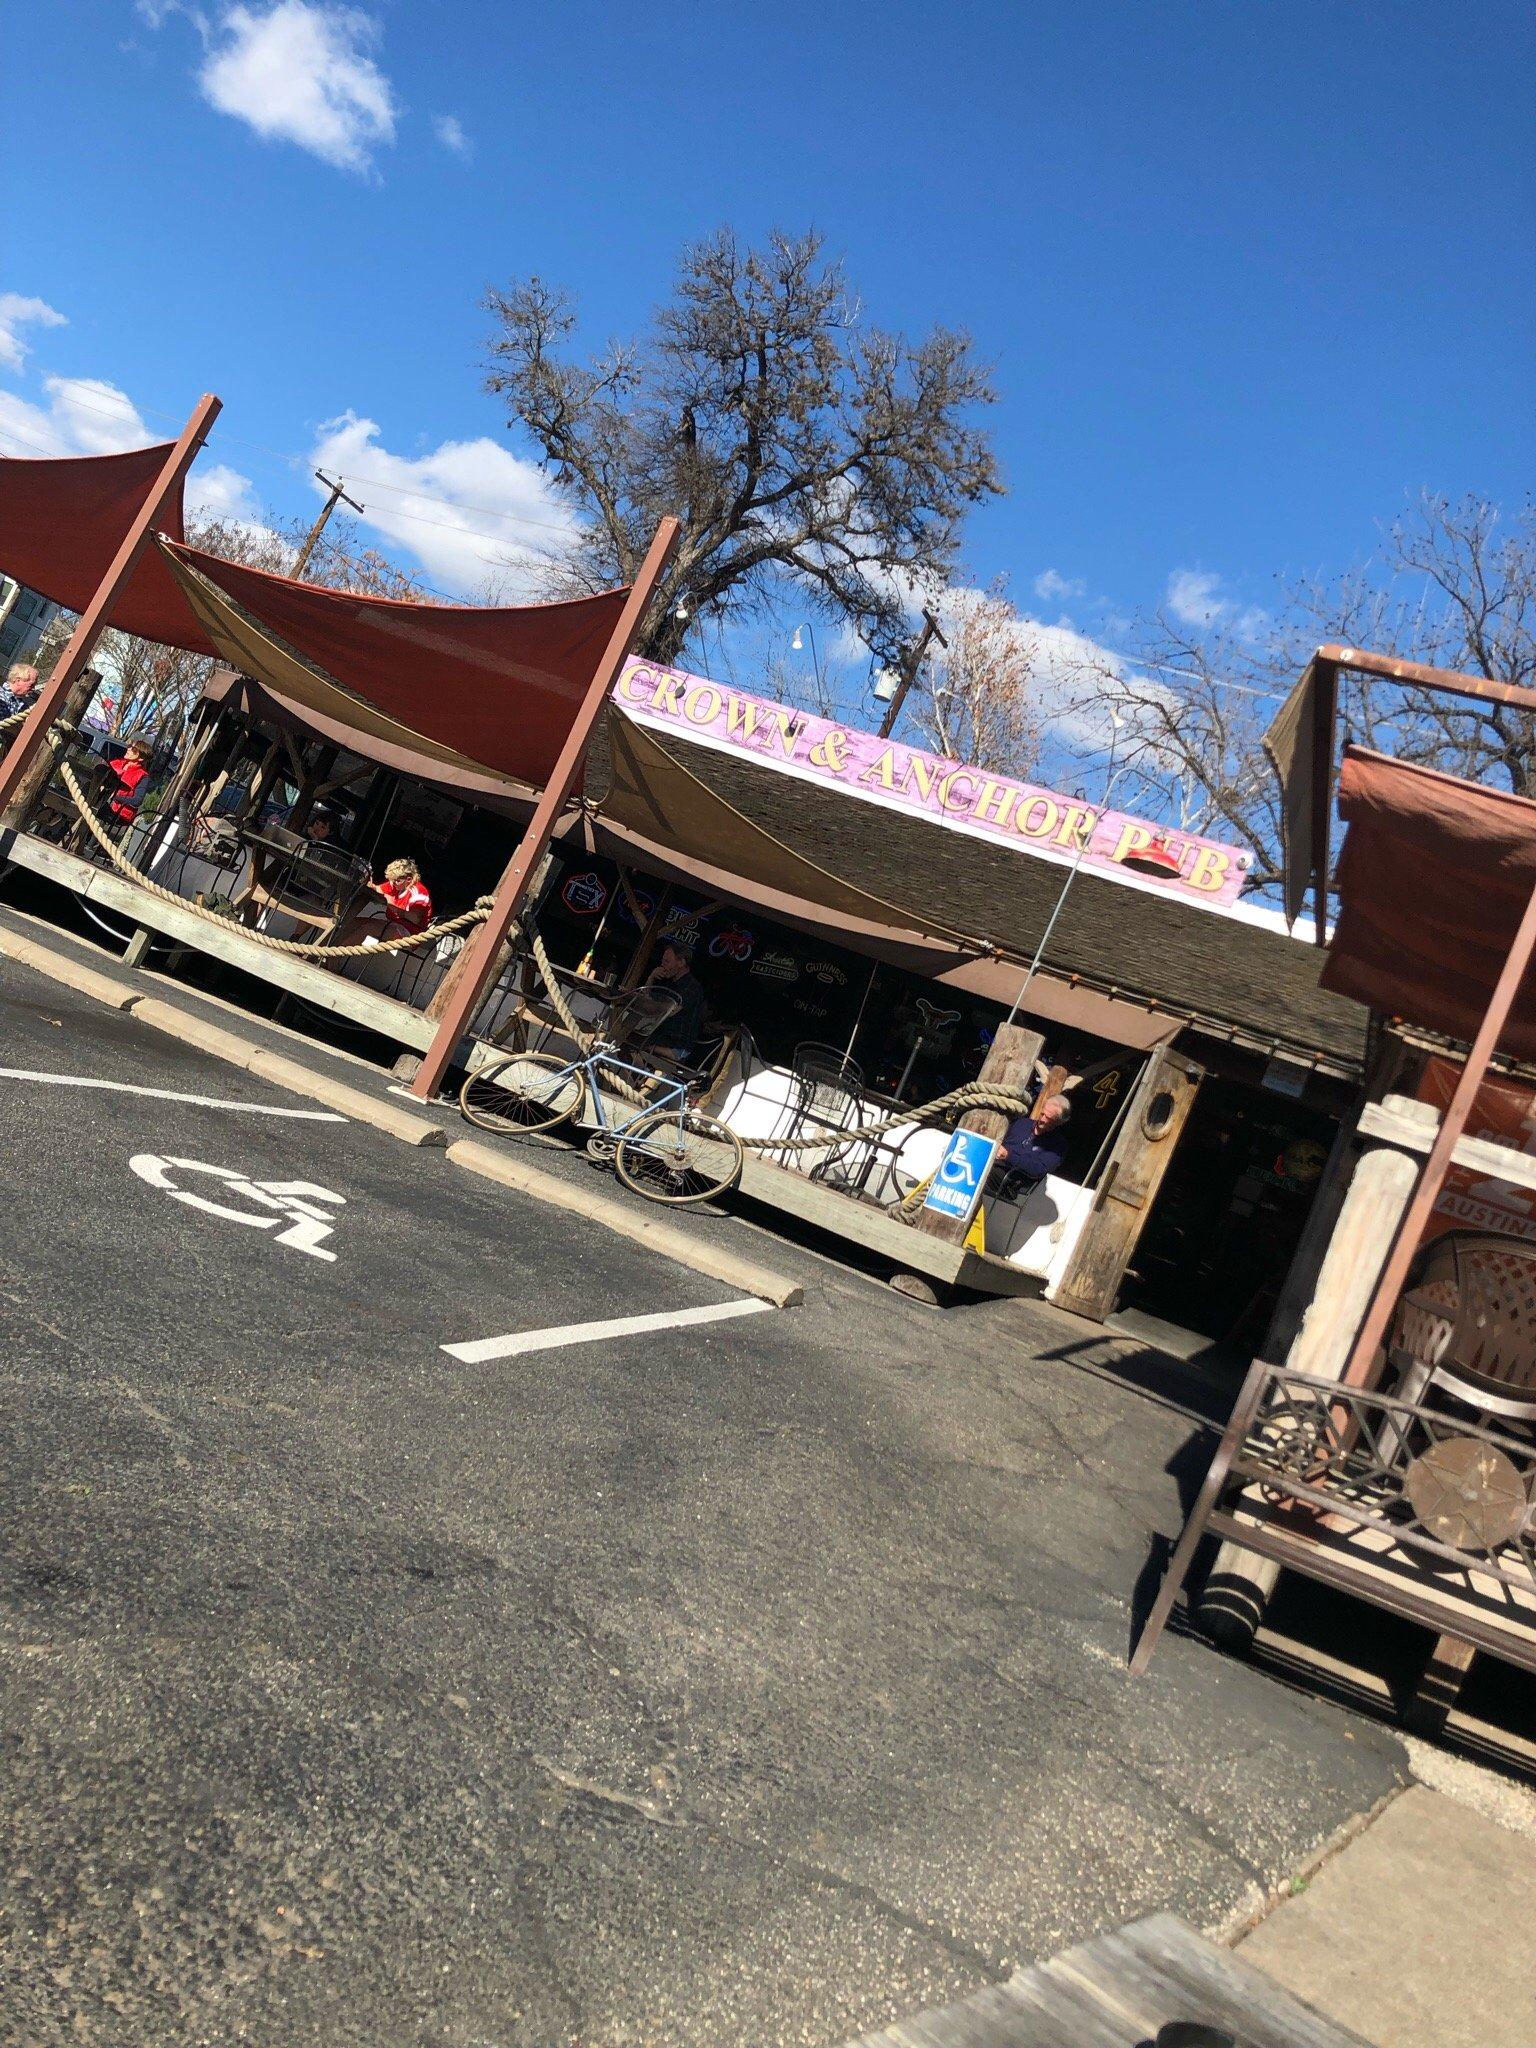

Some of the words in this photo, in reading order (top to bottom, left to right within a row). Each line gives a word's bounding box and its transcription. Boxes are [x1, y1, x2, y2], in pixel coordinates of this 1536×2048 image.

[617, 663, 809, 758] CROWN
[809, 730, 853, 773] &
[858, 745, 1094, 855] ANCHOR
[805, 961, 848, 986] GUINNESS
[1092, 1070, 1120, 1109] 4
[929, 1182, 972, 1213] PARKING
